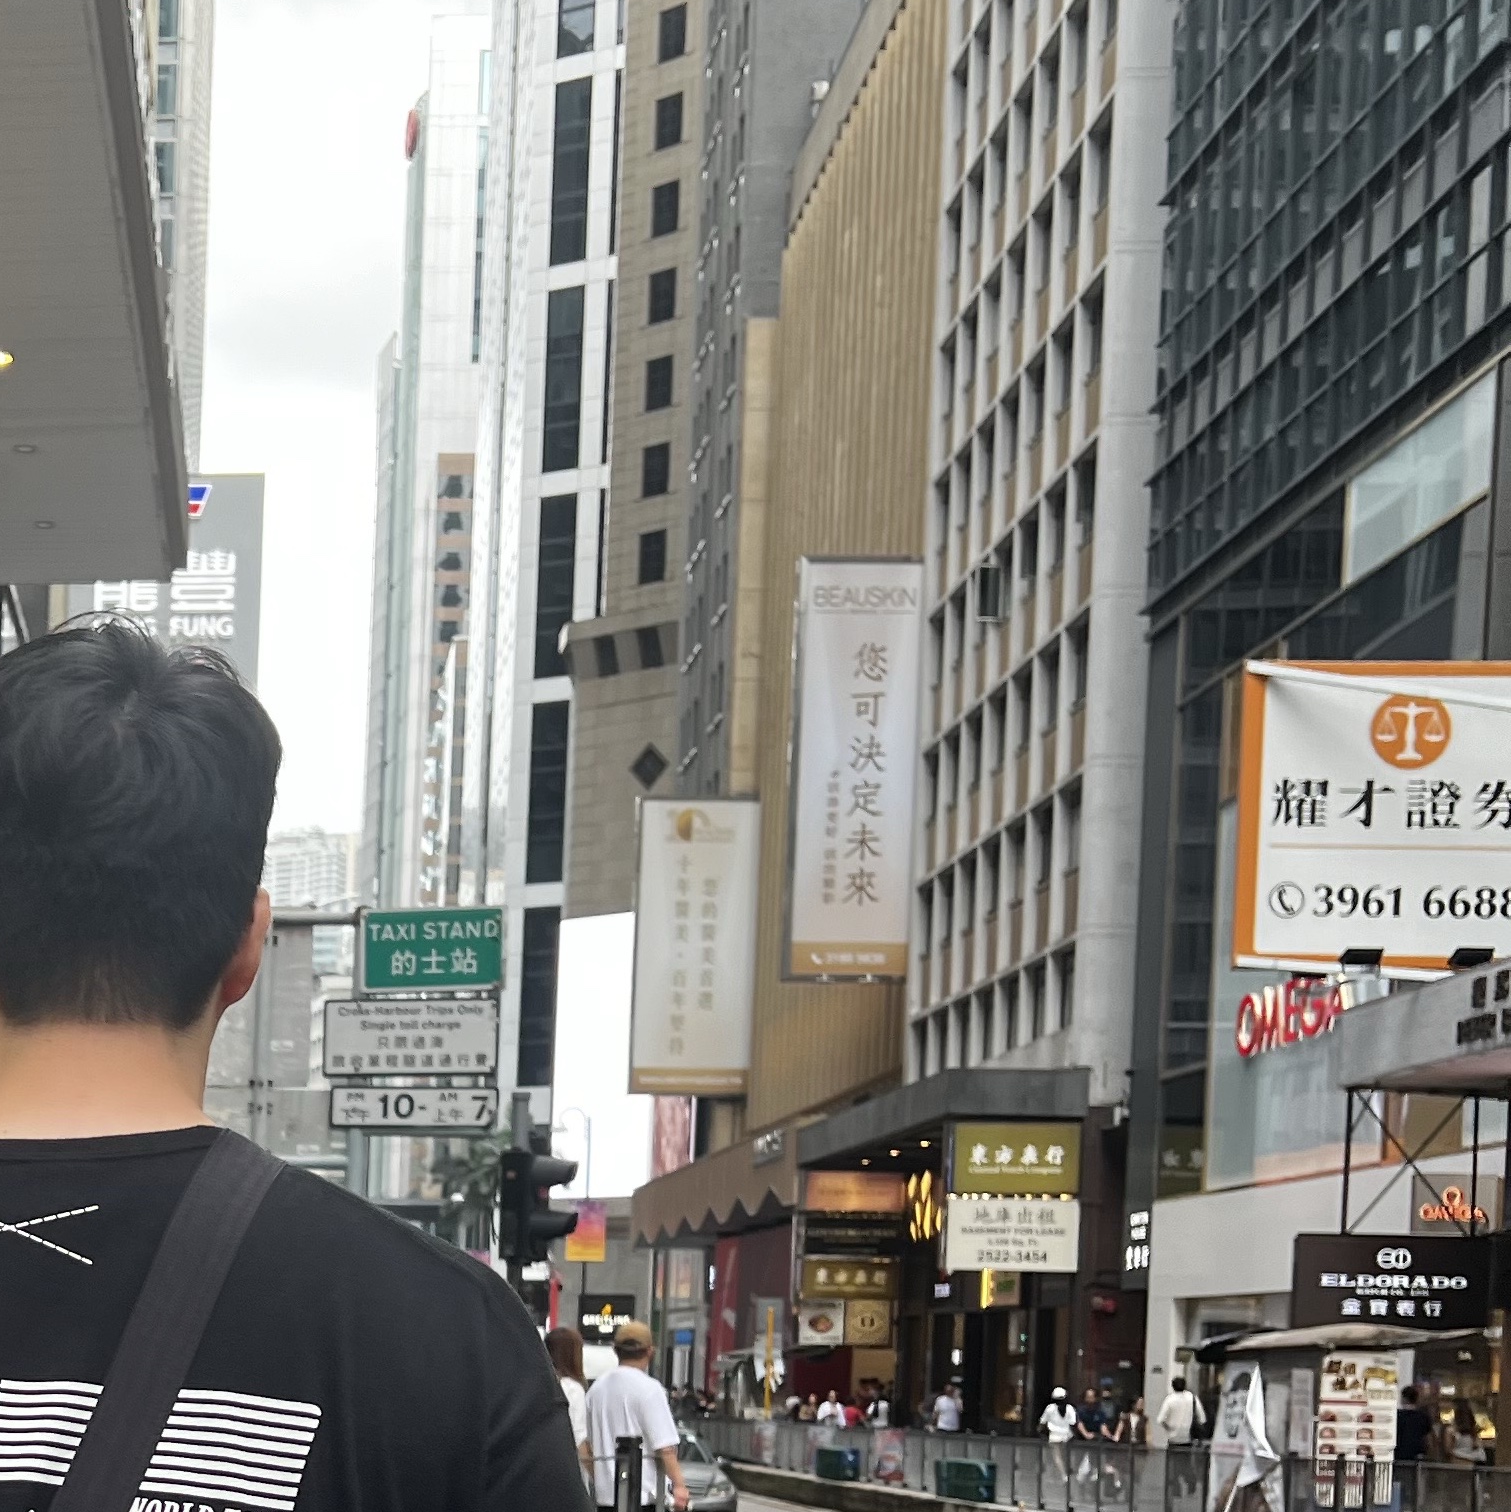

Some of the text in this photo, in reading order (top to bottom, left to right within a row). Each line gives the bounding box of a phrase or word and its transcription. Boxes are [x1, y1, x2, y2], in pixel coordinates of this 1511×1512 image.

[813, 585, 918, 608] BEAUSKIN
[169, 615, 234, 638] FUNG
[842, 642, 887, 906] 您可決定未來
[1272, 777, 1511, 830] 耀才證券
[1312, 883, 1402, 919] 3961
[368, 919, 499, 941] TAXI STAND
[390, 948, 477, 976] 的士站
[1235, 976, 1345, 1058] OMEGA
[439, 1092, 458, 1101] AM
[471, 1096, 489, 1120] 7
[1319, 1272, 1468, 1290] ELDORADO
